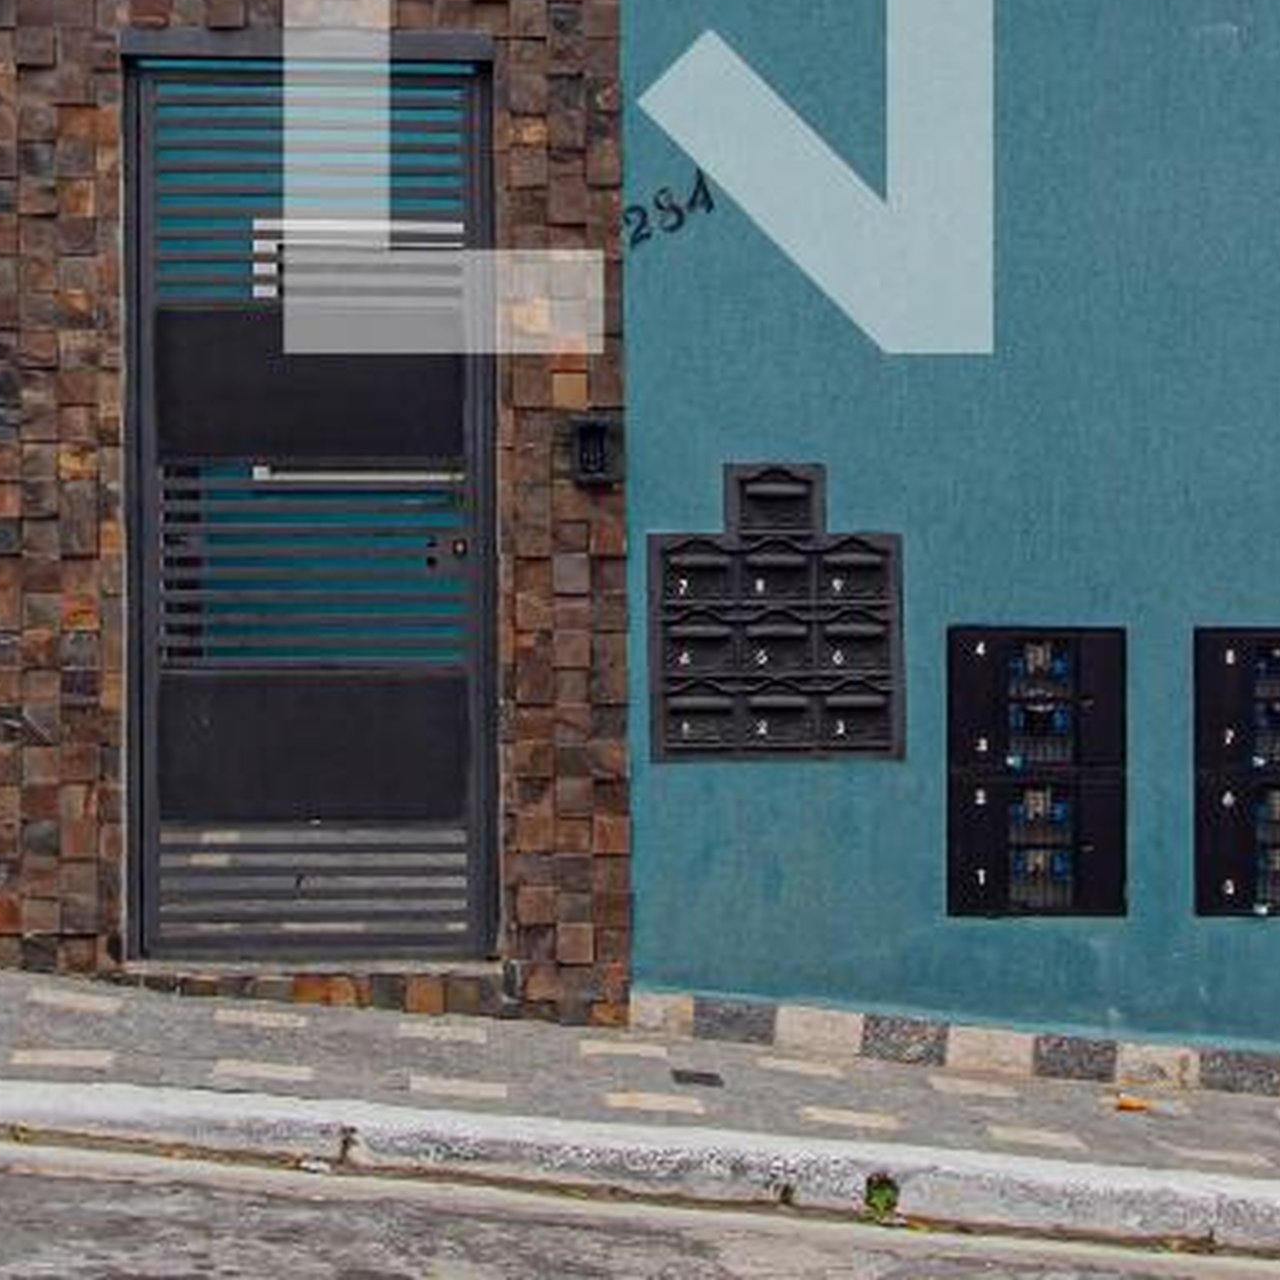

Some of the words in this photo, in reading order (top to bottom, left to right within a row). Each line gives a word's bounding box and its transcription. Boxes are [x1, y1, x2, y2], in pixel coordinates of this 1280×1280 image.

[677, 578, 689, 595] 7
[975, 641, 986, 656] 4
[756, 720, 768, 735] 2
[1225, 729, 1235, 745] 7
[977, 868, 987, 885] 1
